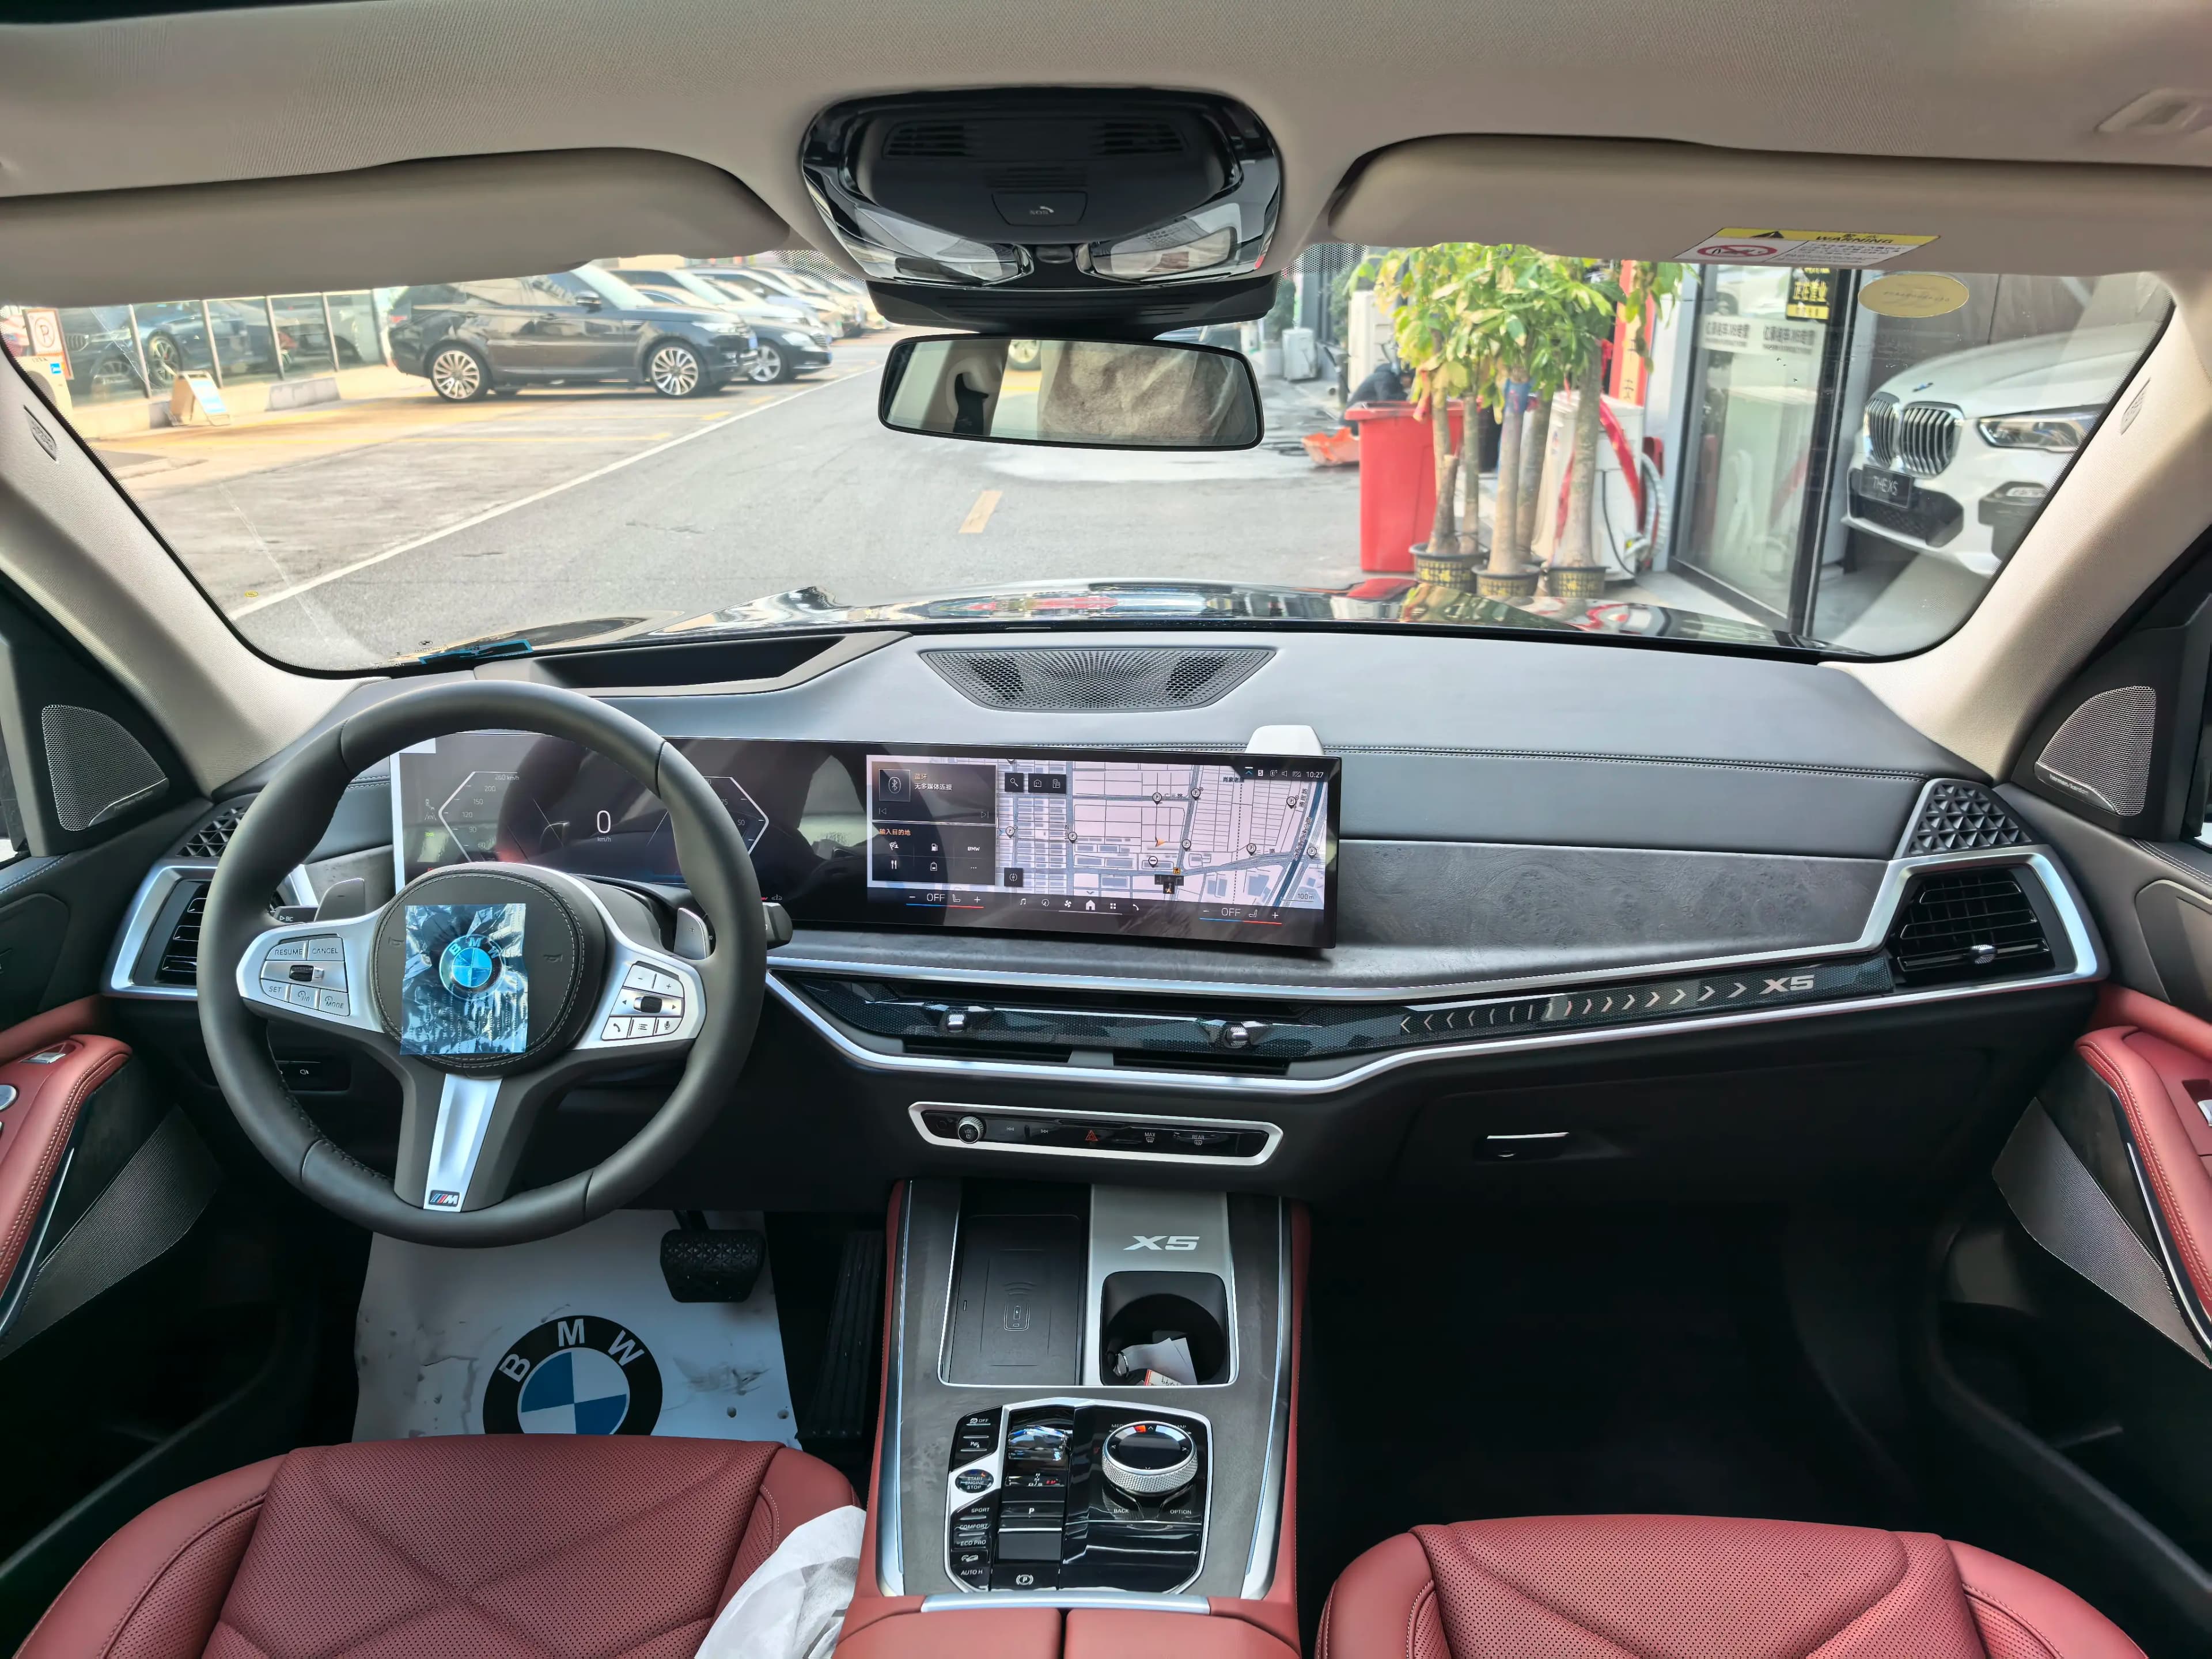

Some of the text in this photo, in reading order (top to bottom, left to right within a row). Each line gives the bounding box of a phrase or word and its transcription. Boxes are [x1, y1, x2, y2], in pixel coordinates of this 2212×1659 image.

[597, 810, 611, 834] 0
[926, 893, 945, 902] OFF
[1221, 907, 1241, 916] OFF
[449, 937, 499, 959] BMW
[1759, 975, 1815, 994] X5
[1123, 1236, 1200, 1250] X5
[498, 1318, 645, 1382] BMW
